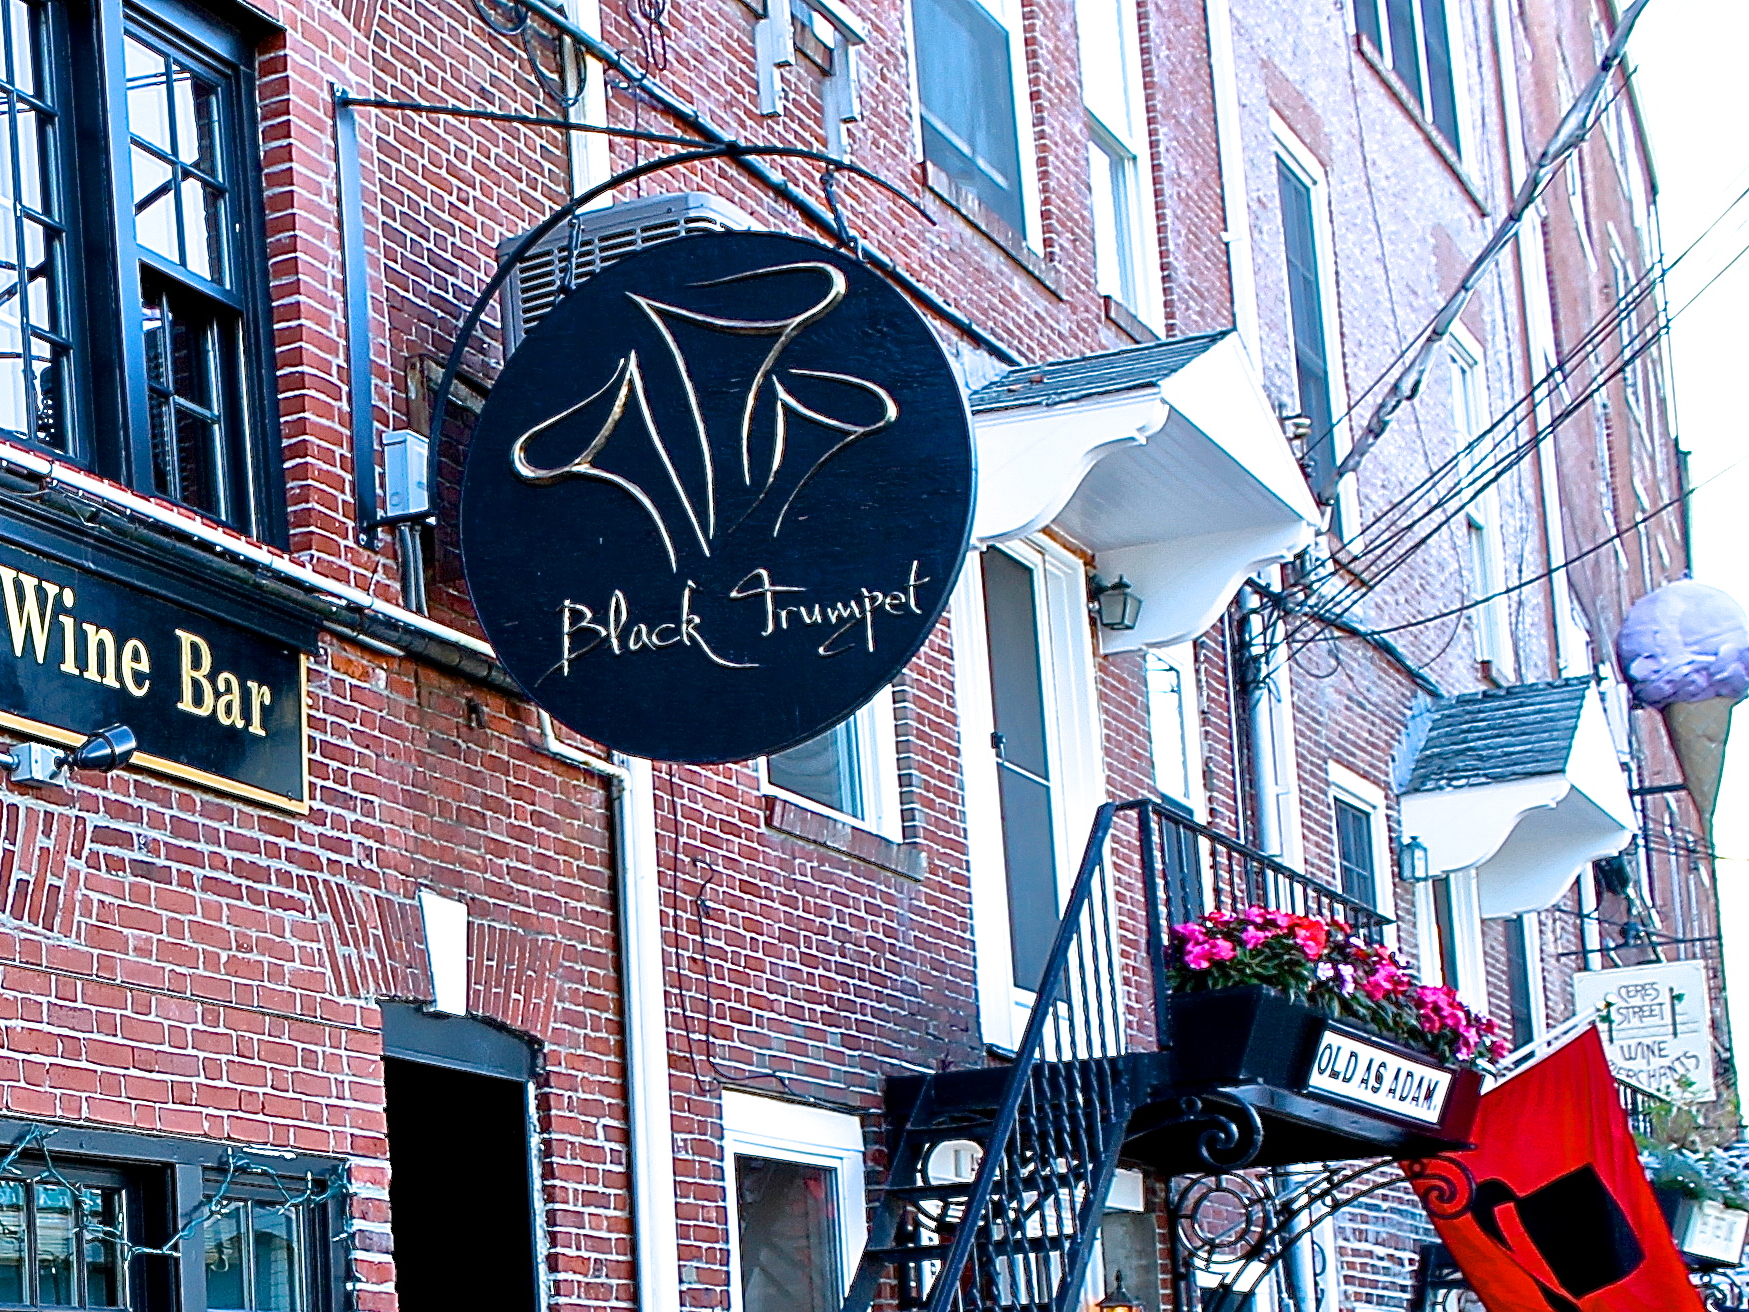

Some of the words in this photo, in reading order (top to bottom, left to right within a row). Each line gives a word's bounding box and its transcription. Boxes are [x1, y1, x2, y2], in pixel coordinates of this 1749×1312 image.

[536, 580, 759, 687] Black
[730, 561, 930, 657] Trumpet
[174, 628, 271, 737] Bar
[1618, 981, 1660, 1003] CERES
[1617, 1002, 1665, 1026] STREET
[1317, 1043, 1359, 1083] OLD
[1357, 1057, 1388, 1094] AS
[1620, 1040, 1669, 1066] WINE
